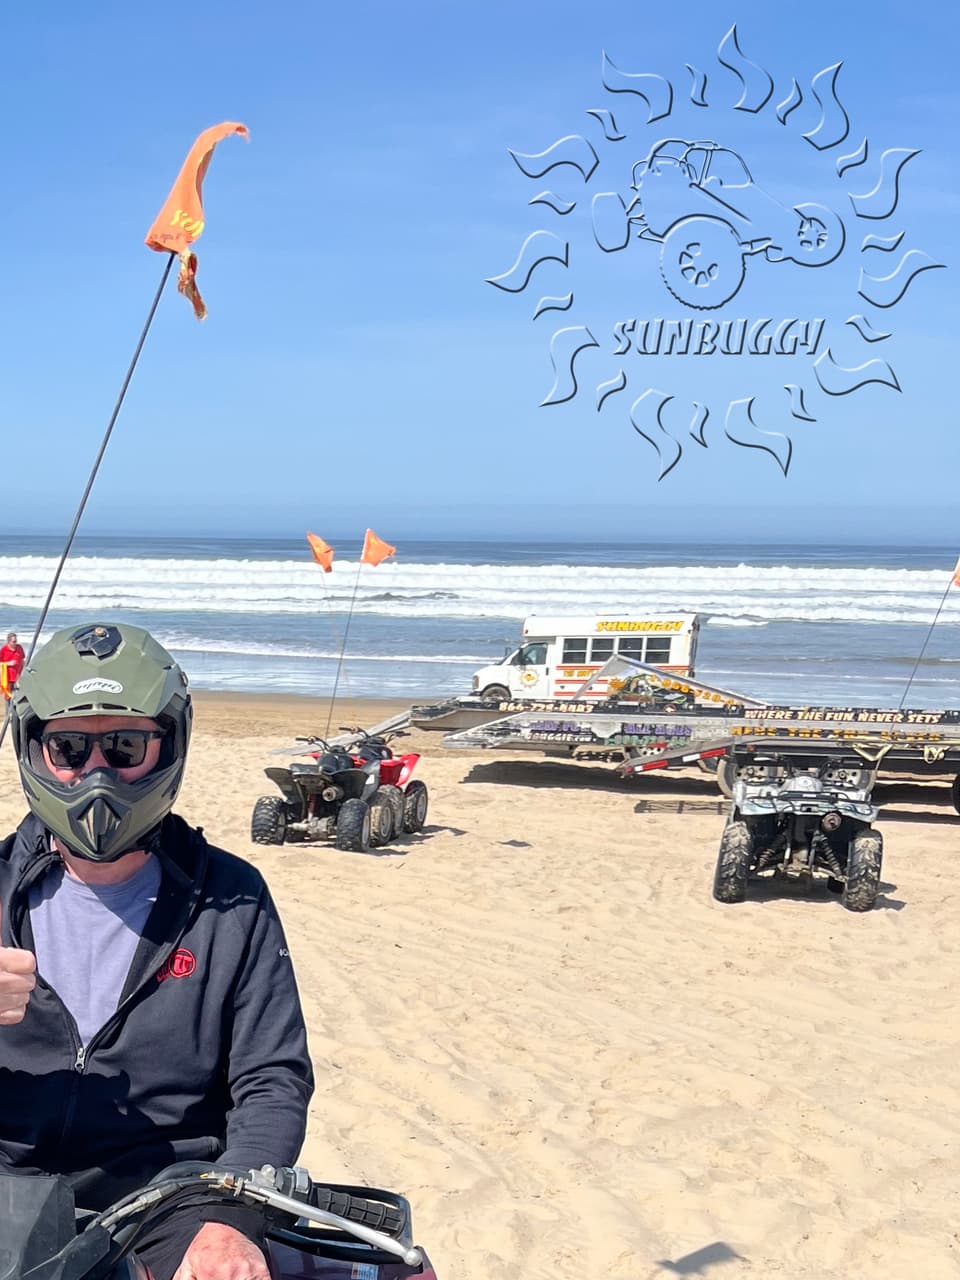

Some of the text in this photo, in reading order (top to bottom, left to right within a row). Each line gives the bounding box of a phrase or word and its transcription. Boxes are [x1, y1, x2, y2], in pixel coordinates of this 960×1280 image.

[744, 709, 942, 724] WHERE THE FUN NEVER SETS
